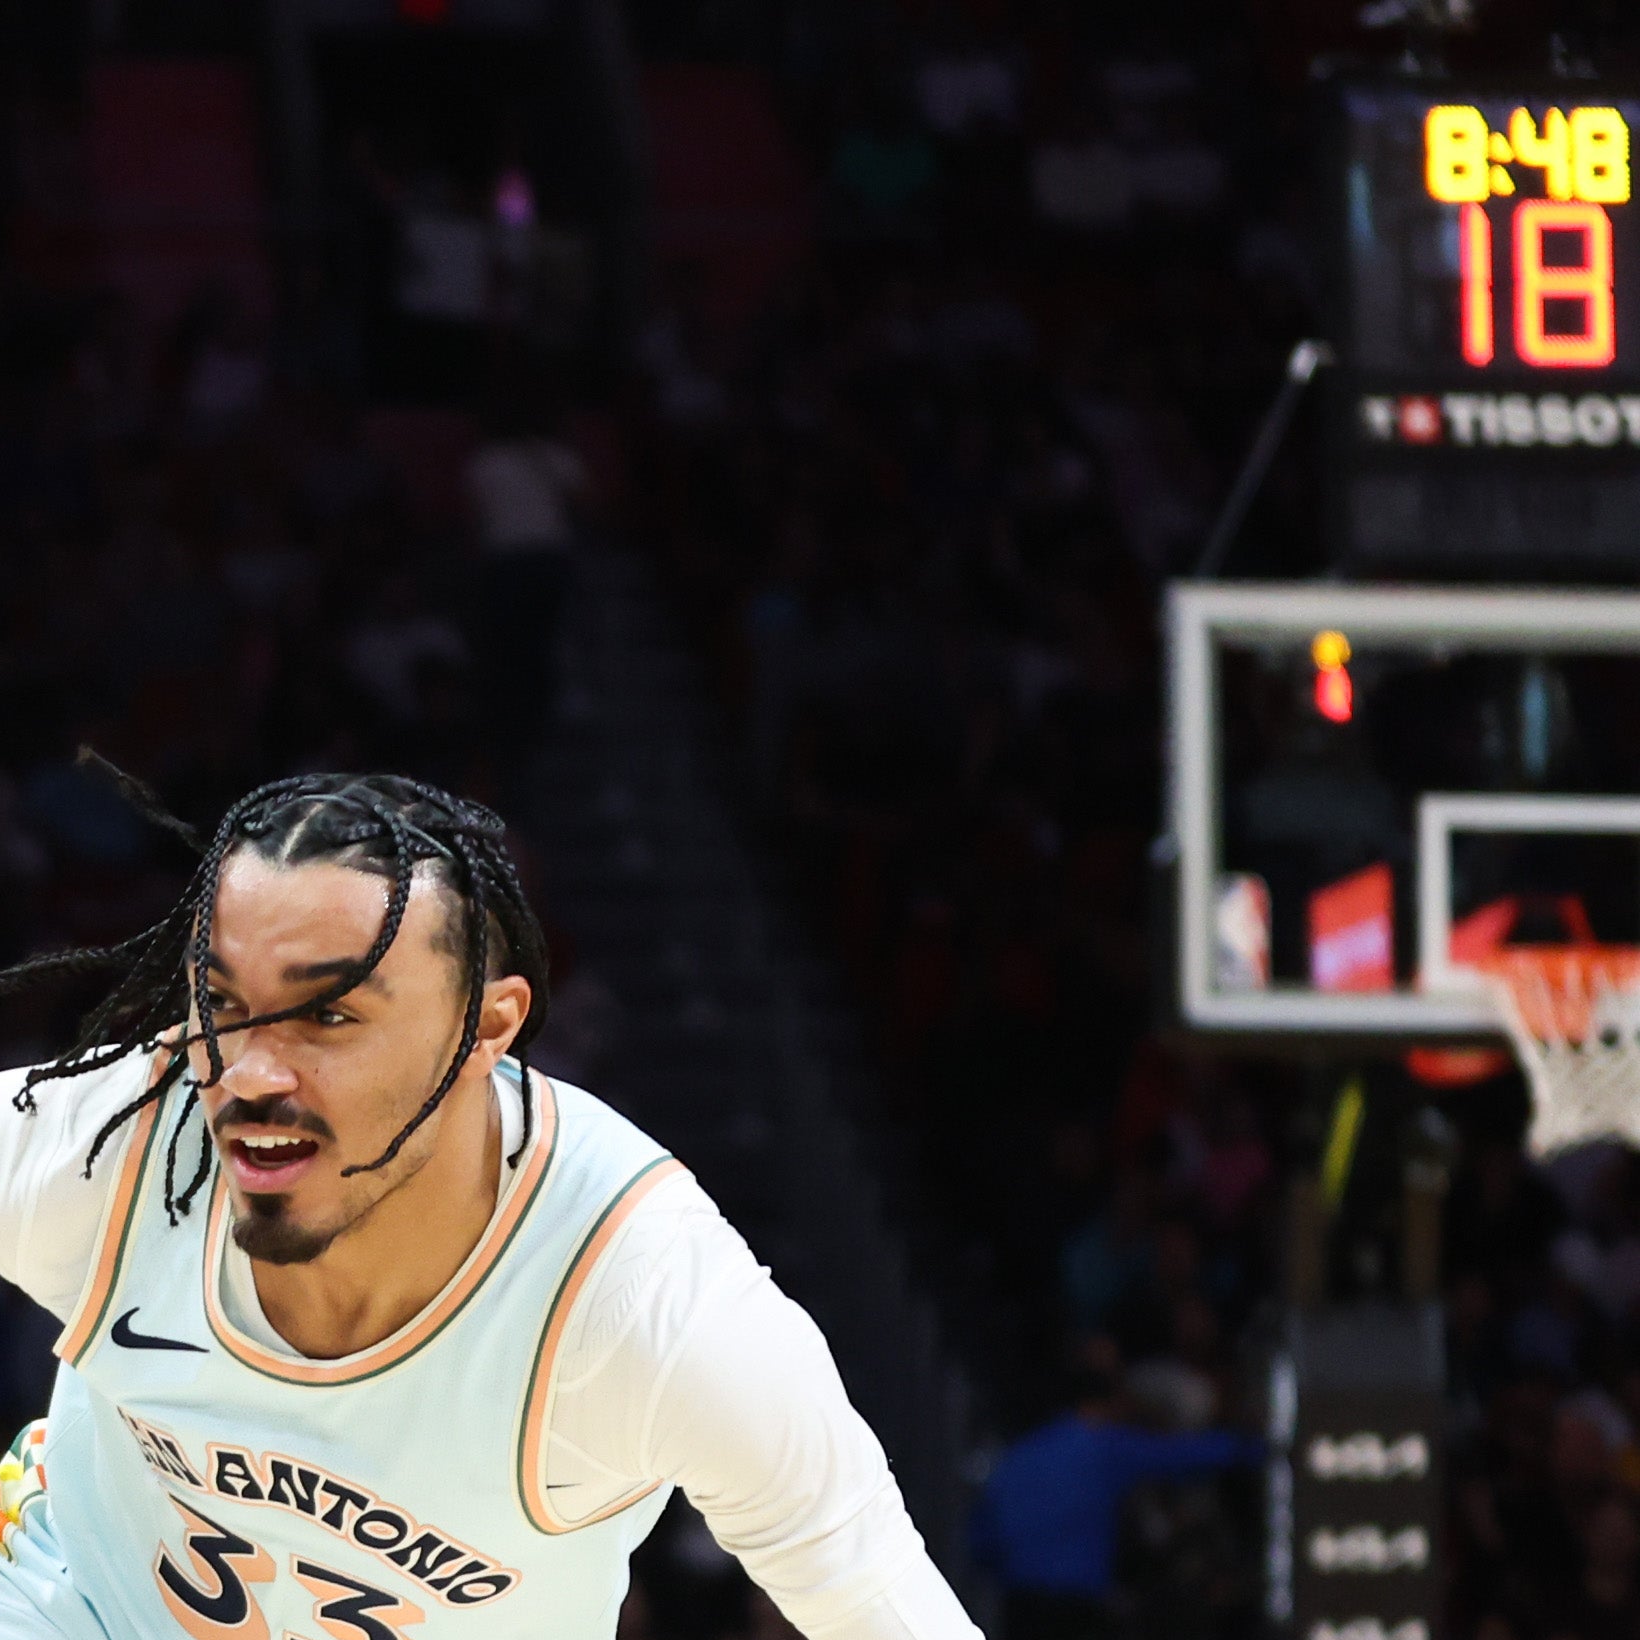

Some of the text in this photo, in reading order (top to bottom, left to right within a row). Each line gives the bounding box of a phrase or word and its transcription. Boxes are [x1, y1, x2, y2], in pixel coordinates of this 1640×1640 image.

[1425, 105, 1630, 203] 8:48
[1458, 199, 1615, 368] 18
[206, 1442, 522, 1609] ANTONIO
